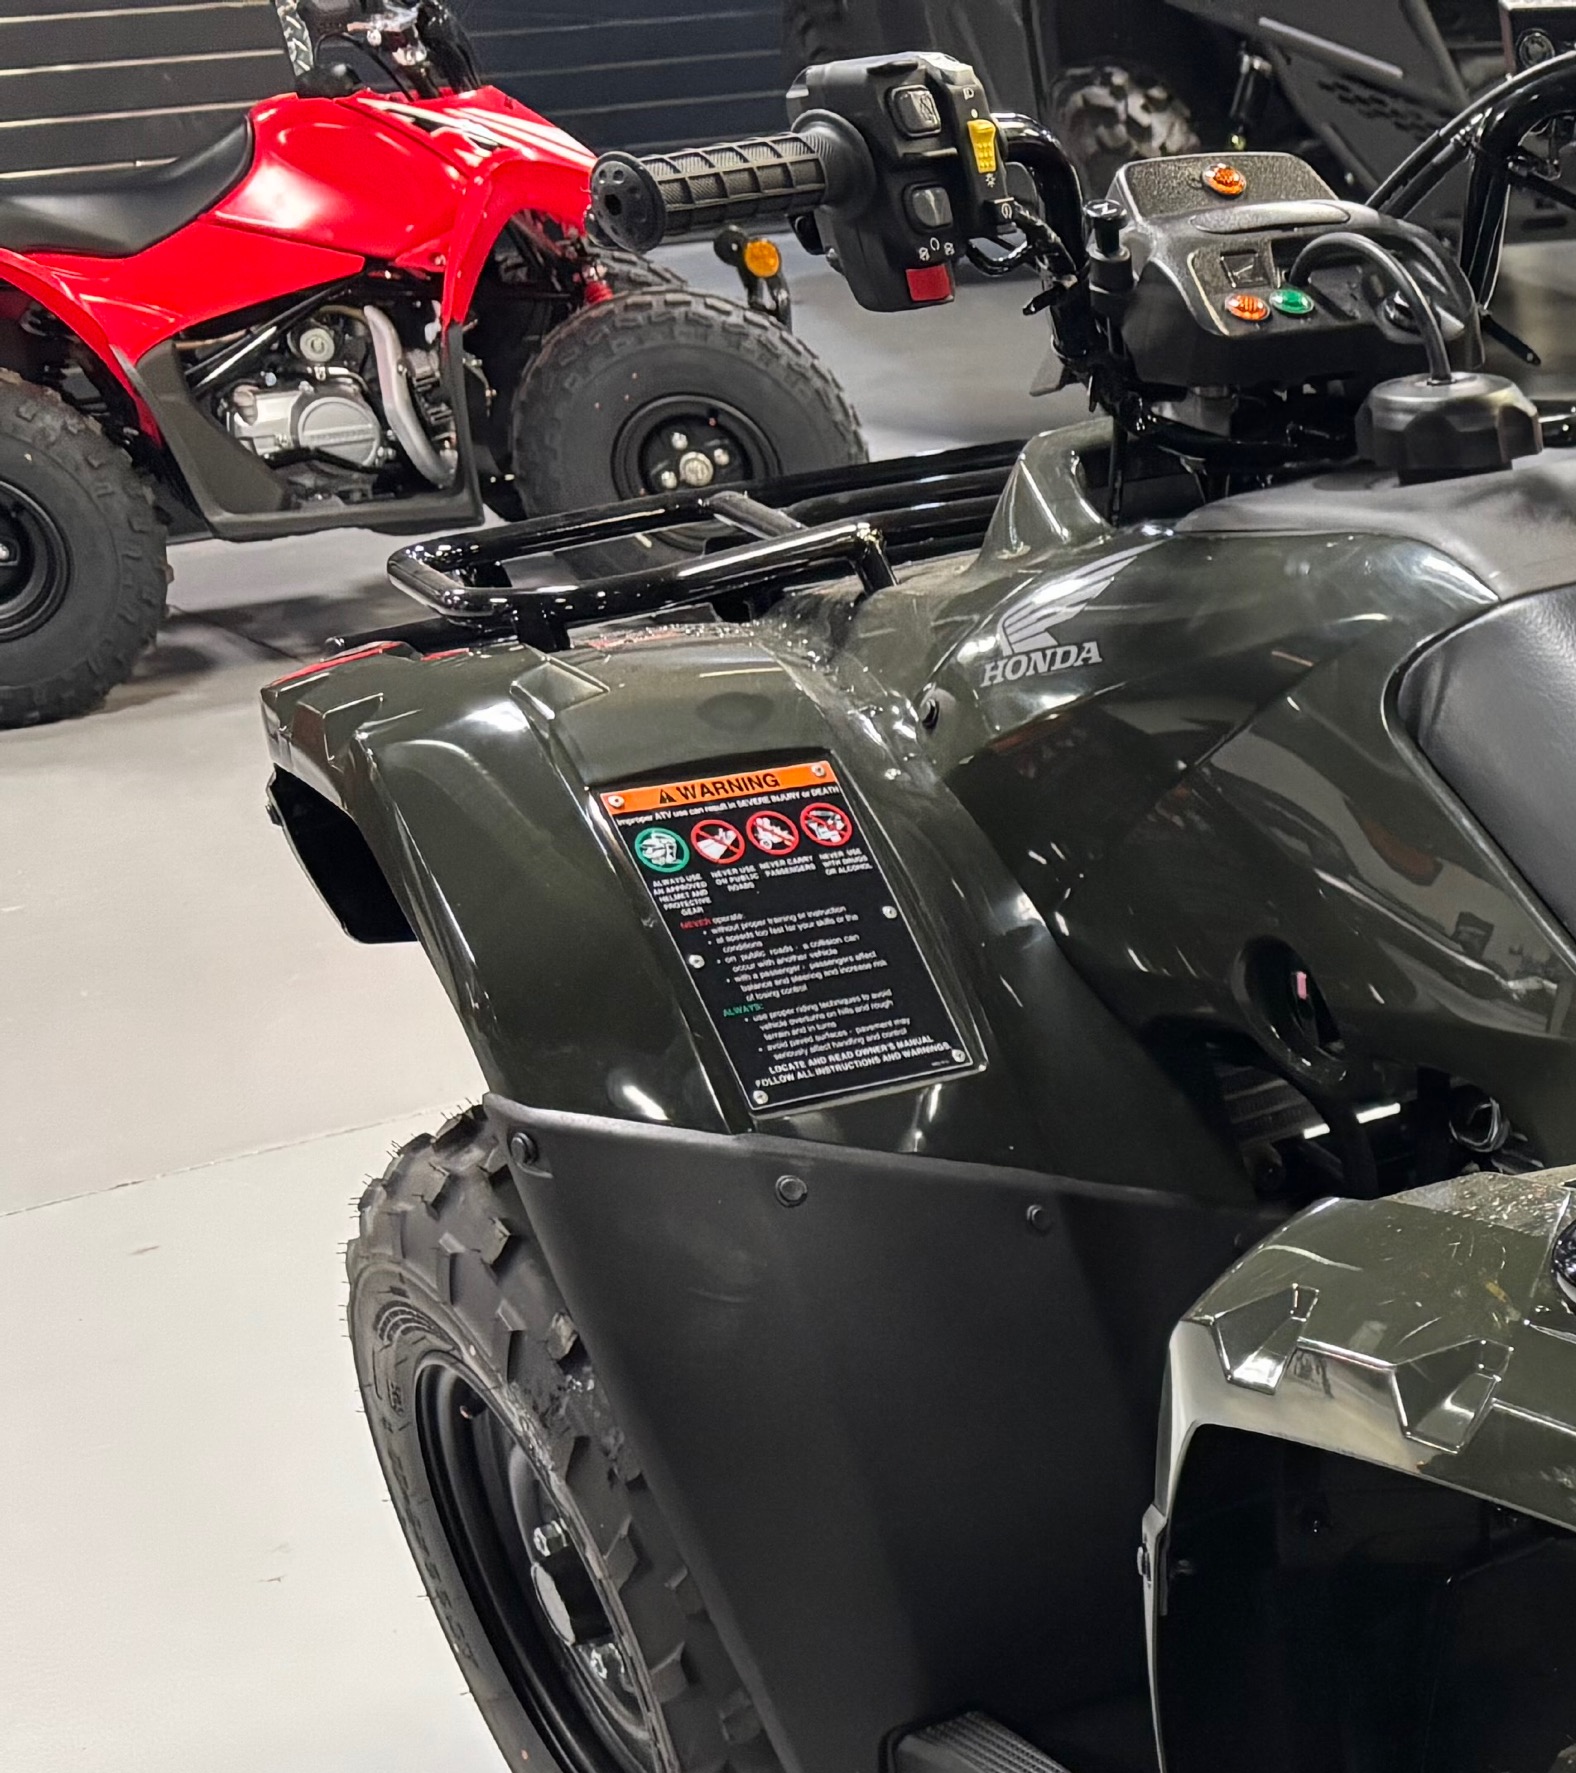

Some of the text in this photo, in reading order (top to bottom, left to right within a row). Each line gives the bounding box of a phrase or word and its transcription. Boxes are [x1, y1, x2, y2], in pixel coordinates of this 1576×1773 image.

[980, 641, 1103, 688] HONDA
[676, 773, 780, 800] WARNING
[616, 814, 653, 825] Improper
[704, 803, 726, 812] result
[737, 797, 769, 807] SEVERE
[770, 792, 800, 801] INJURY
[810, 786, 839, 795] DEATH
[818, 851, 843, 859] NEVER
[841, 855, 868, 863] DRUGS
[759, 856, 813, 869] NEVER CARRY
[837, 862, 872, 873] ALCOHOL
[710, 869, 737, 877] NEVER
[765, 864, 816, 876] PASSENGERS
[652, 877, 685, 886] ALWAYS
[728, 873, 759, 882] PUBLIC
[665, 882, 707, 892] APPROVED
[727, 882, 754, 891] ROADS
[659, 893, 690, 902] HELMET
[663, 897, 711, 910] PROTECTIVE
[680, 907, 704, 915] GEAR
[680, 918, 711, 928] NEVER
[711, 925, 738, 934] without
[740, 921, 766, 930] proper
[767, 914, 796, 925] training
[807, 905, 846, 917] instruction
[725, 932, 754, 942] speeds
[722, 941, 763, 952] conditions
[739, 950, 765, 960] public
[769, 945, 793, 954] roads
[809, 936, 842, 947] collision
[732, 964, 755, 972] occur
[776, 954, 806, 964] another
[809, 948, 837, 957] vehicle
[734, 974, 751, 982] with
[759, 966, 801, 978] passenger
[808, 956, 853, 969] passengers
[854, 951, 876, 959] affect
[740, 981, 772, 991] balance
[790, 972, 822, 983] steering
[823, 968, 838, 976] and
[839, 962, 871, 973] increase
[754, 990, 779, 1000] losing
[780, 984, 807, 994] control
[721, 1003, 763, 1016] ALWAYS:
[769, 1009, 795, 1019] proper
[796, 1004, 818, 1013] riding
[819, 995, 860, 1009] techniques
[870, 989, 891, 997] avoid
[759, 1021, 787, 1030] vehicle
[789, 1014, 825, 1025] overturns
[837, 1007, 853, 1015] hills
[870, 1000, 894, 1010] rough
[763, 1030, 789, 1040] terrain
[816, 1021, 836, 1029] turns
[766, 1018, 911, 1051] avoid paved surfaces pavement may
[773, 1048, 808, 1061] seriously
[809, 1043, 830, 1052] affect
[831, 1036, 865, 1049] handling
[881, 1028, 907, 1037] control
[769, 1034, 933, 1074] LOCATE AND READ OWNER'S MANUAL
[755, 1074, 795, 1088] FOLLOW
[795, 1069, 814, 1079] ALL
[814, 1055, 881, 1075] INSTRUCTIONS
[881, 1051, 901, 1061] AND
